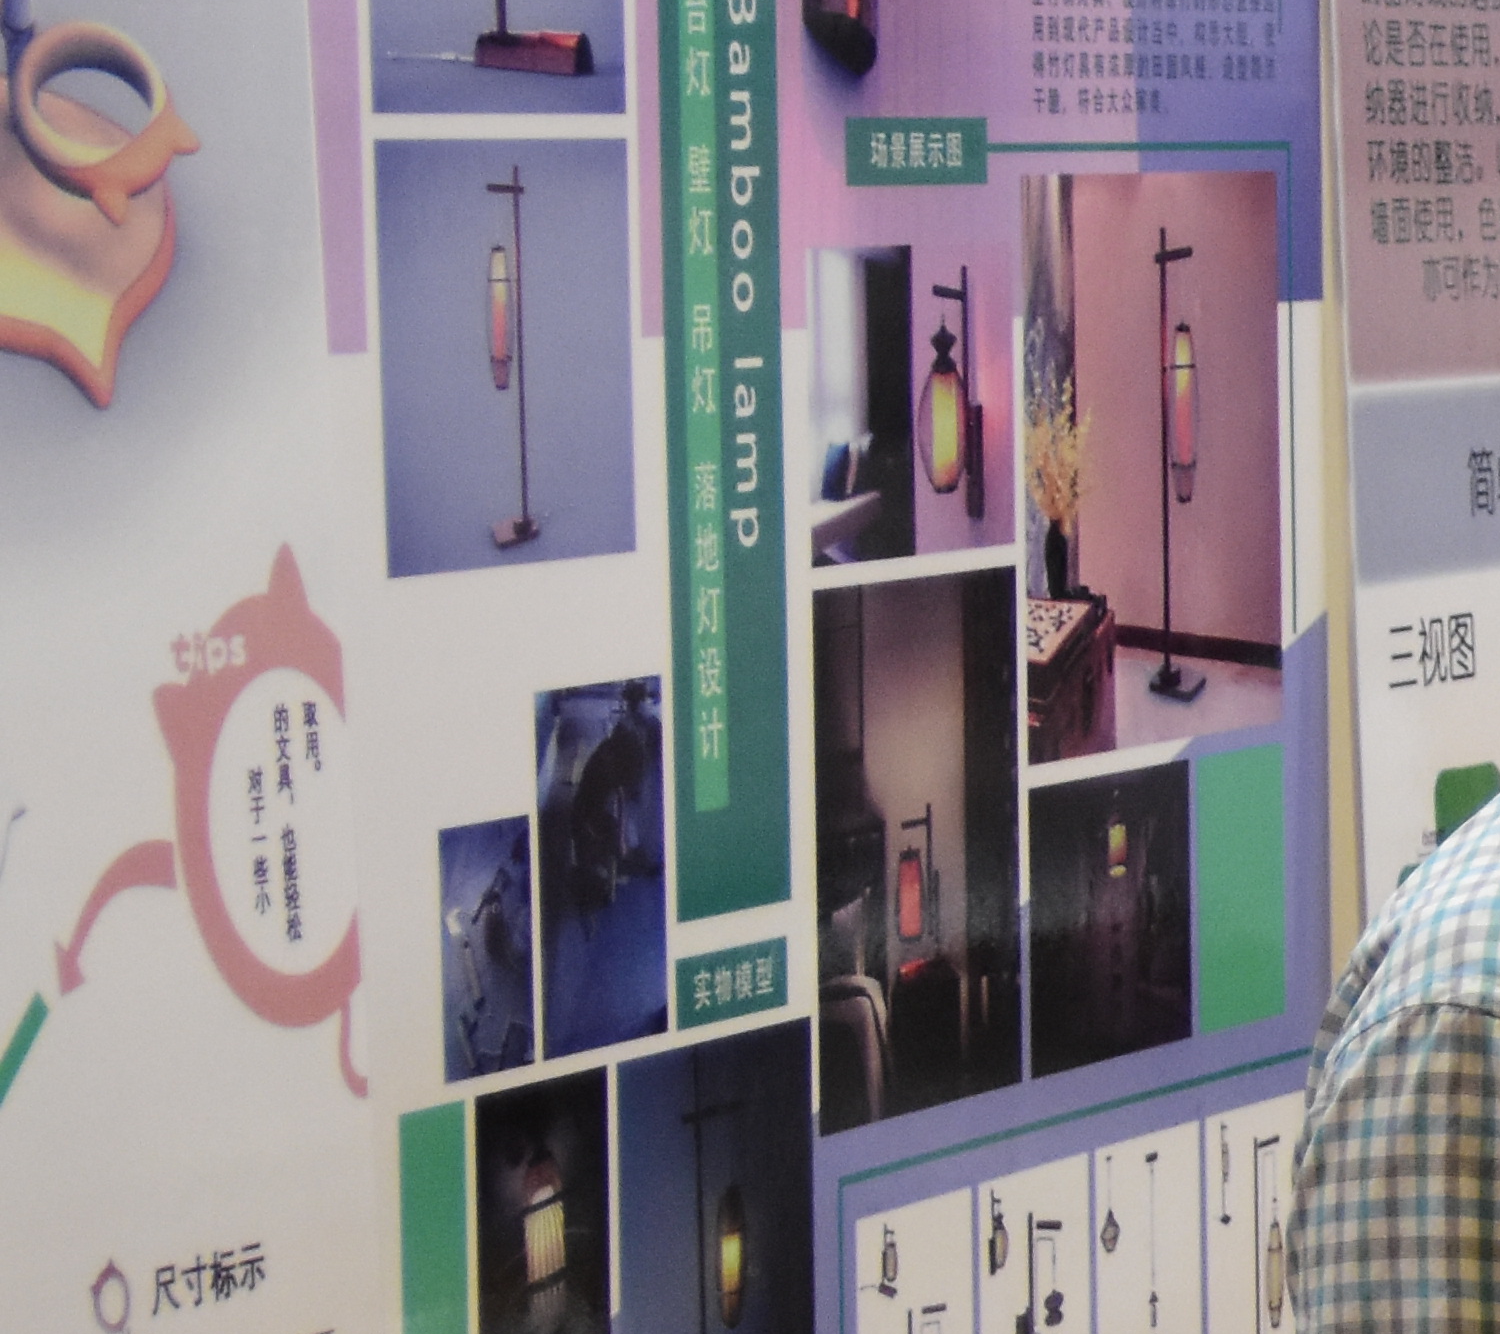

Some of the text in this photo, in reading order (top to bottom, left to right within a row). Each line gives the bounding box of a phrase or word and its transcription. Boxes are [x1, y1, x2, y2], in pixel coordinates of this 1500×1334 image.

[871, 130, 963, 168] 场景展示图
[730, 356, 764, 548] lamp
[170, 632, 247, 673] tips
[1389, 612, 1476, 689] 三视图
[693, 955, 775, 1012] 实物模型
[152, 1242, 267, 1317] 尺寸标示
